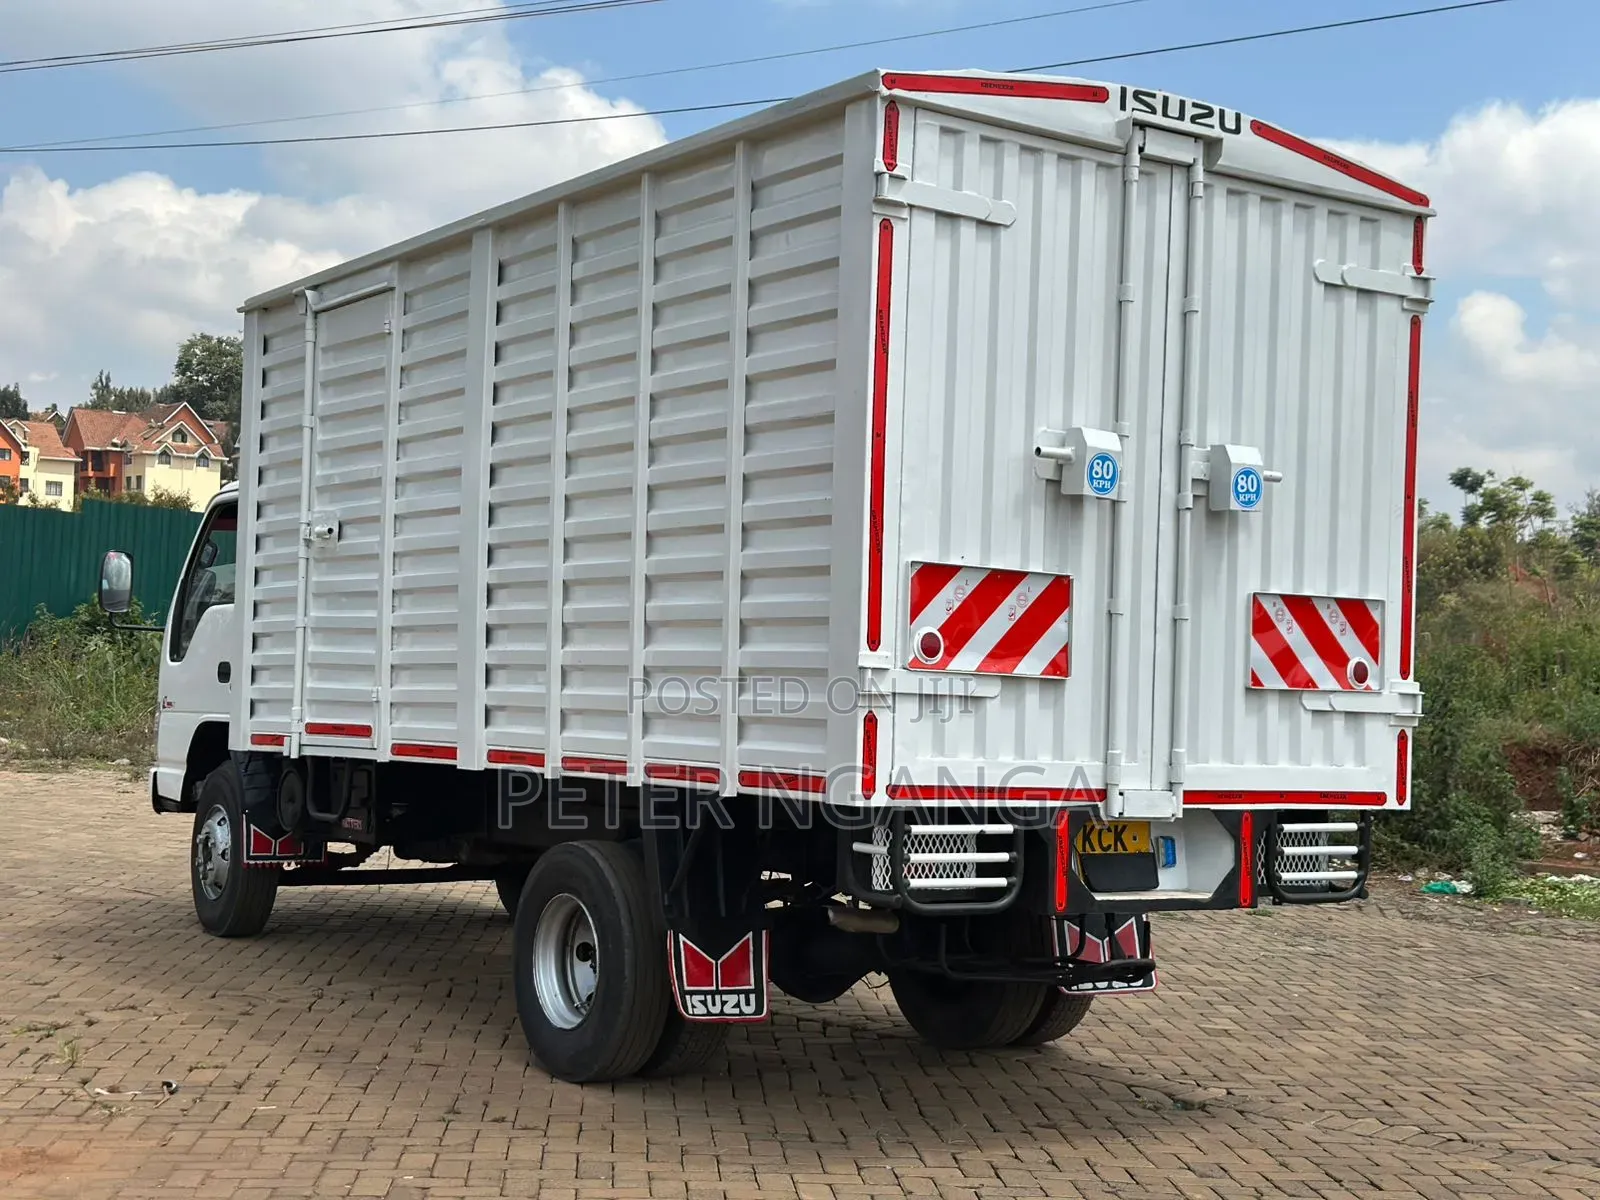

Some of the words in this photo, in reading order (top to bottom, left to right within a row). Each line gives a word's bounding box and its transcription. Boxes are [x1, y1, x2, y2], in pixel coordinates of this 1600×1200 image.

[1120, 86, 1242, 135] ISUZU
[1091, 459, 1113, 479] 80
[1092, 479, 1111, 490] KPH
[1237, 474, 1258, 493] 80
[1238, 493, 1257, 503] KPH
[1082, 824, 1129, 852] KCK
[685, 993, 756, 1015] ISUZU
